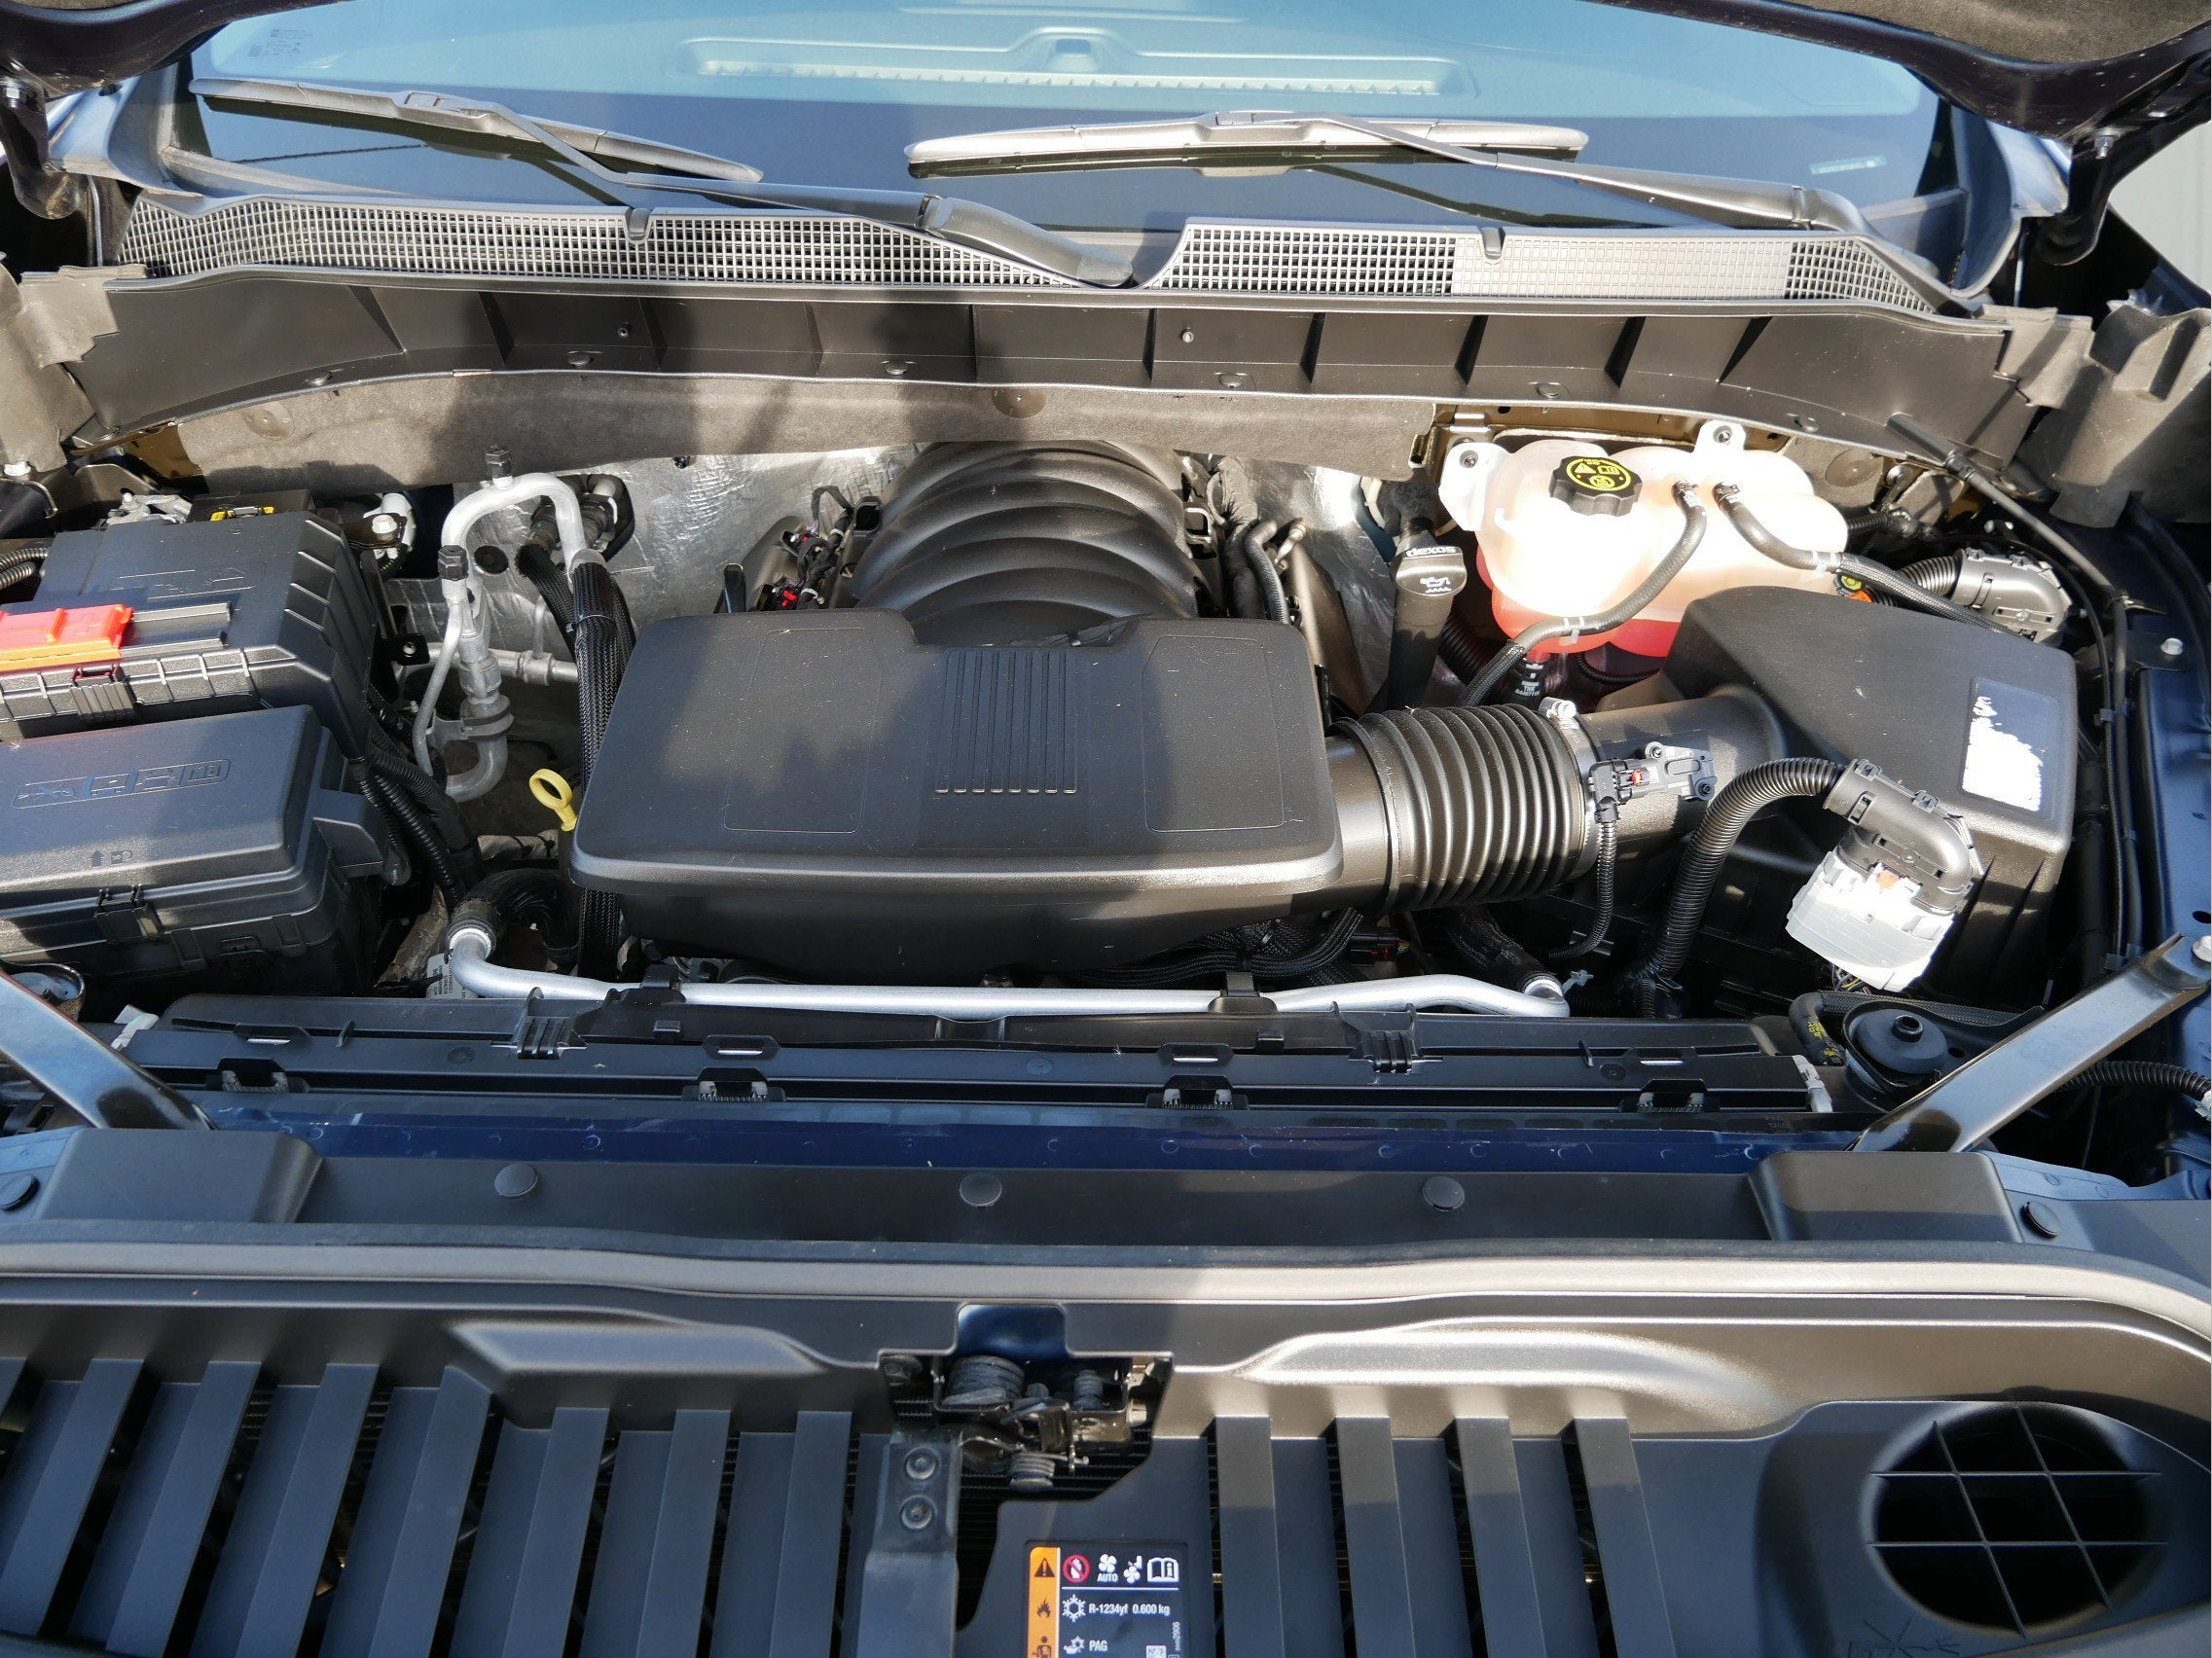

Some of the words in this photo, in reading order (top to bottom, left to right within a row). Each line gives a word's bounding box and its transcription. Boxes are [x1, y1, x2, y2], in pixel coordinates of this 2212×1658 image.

[1097, 1572, 1119, 1583] AUTO
[1088, 1604, 1129, 1616] R-1234yf
[1158, 1604, 1171, 1616] kg
[1089, 1640, 1108, 1652] PAG
